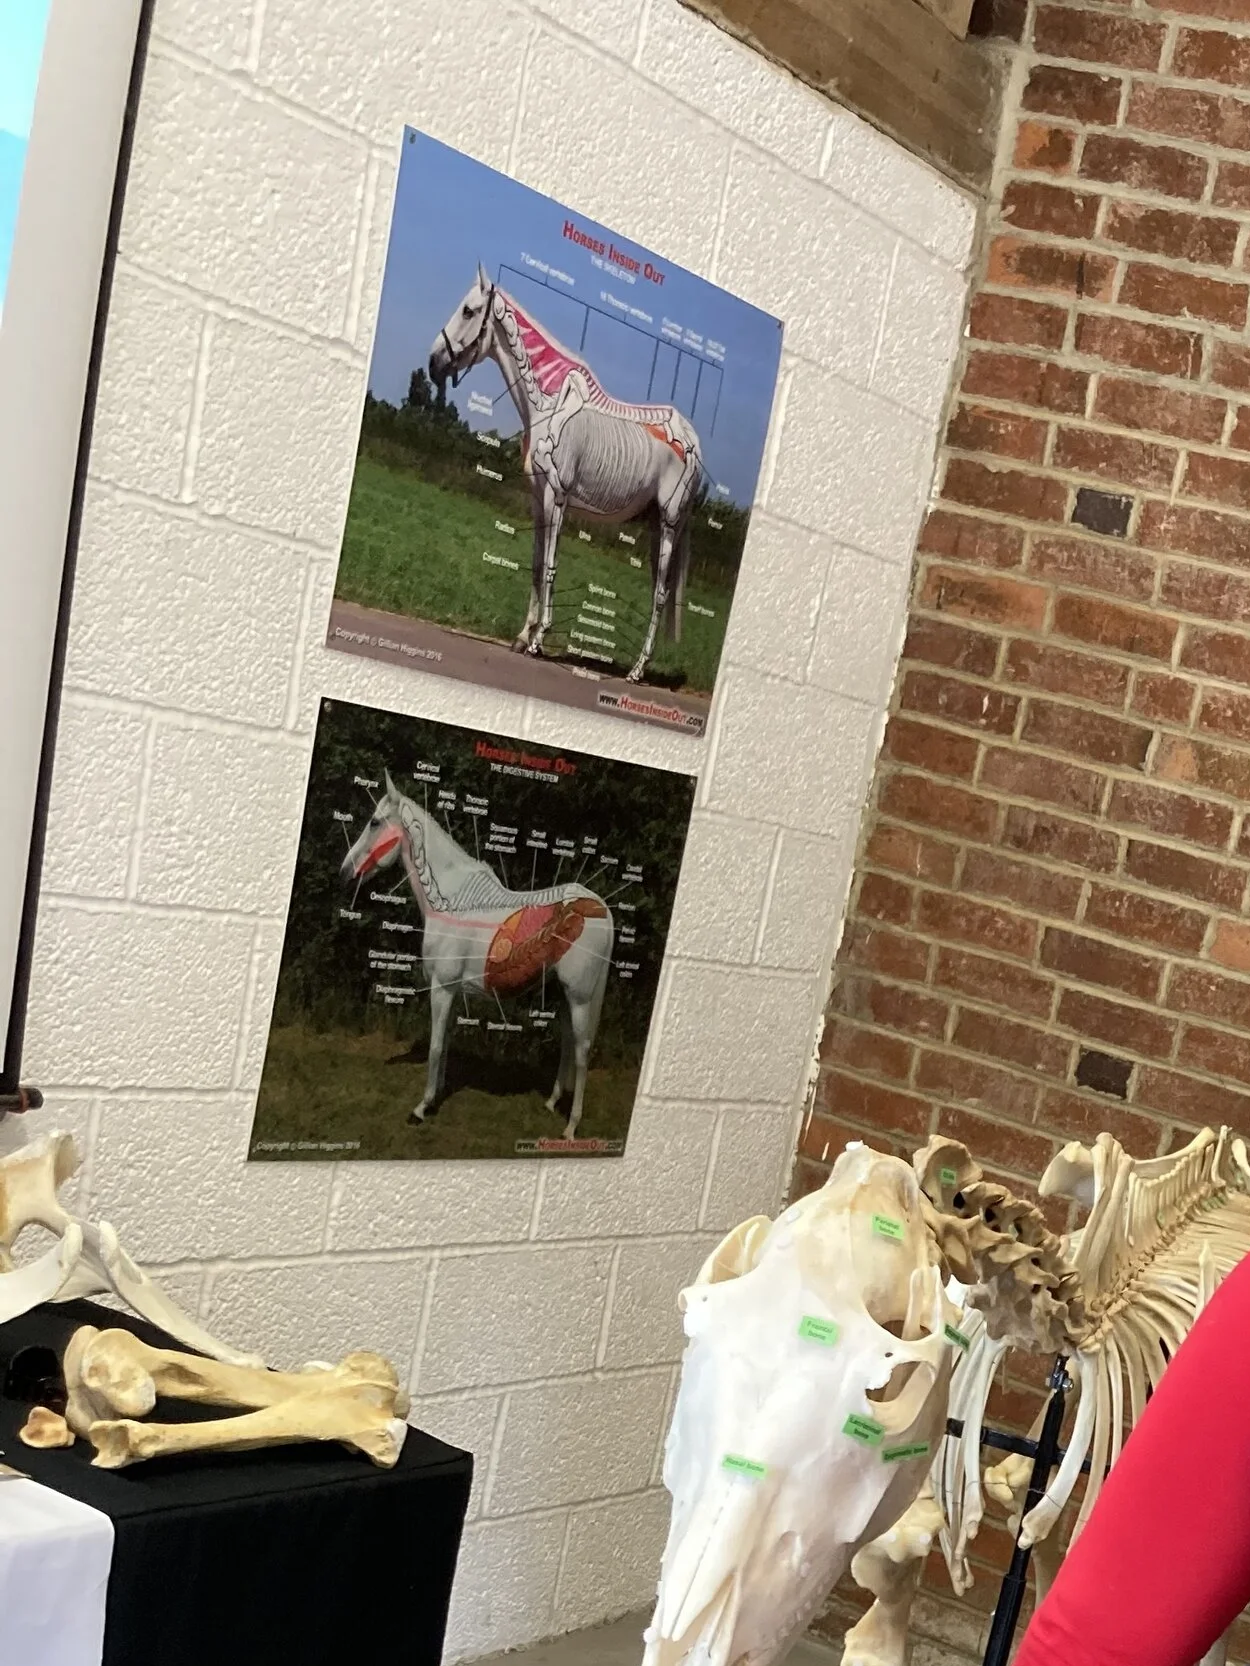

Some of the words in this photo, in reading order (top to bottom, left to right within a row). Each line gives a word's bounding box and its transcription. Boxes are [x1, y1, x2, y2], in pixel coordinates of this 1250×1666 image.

[562, 220, 605, 256] HORSES
[608, 243, 641, 273] INSIDE
[643, 262, 666, 286] OUT
[490, 762, 502, 773] THE
